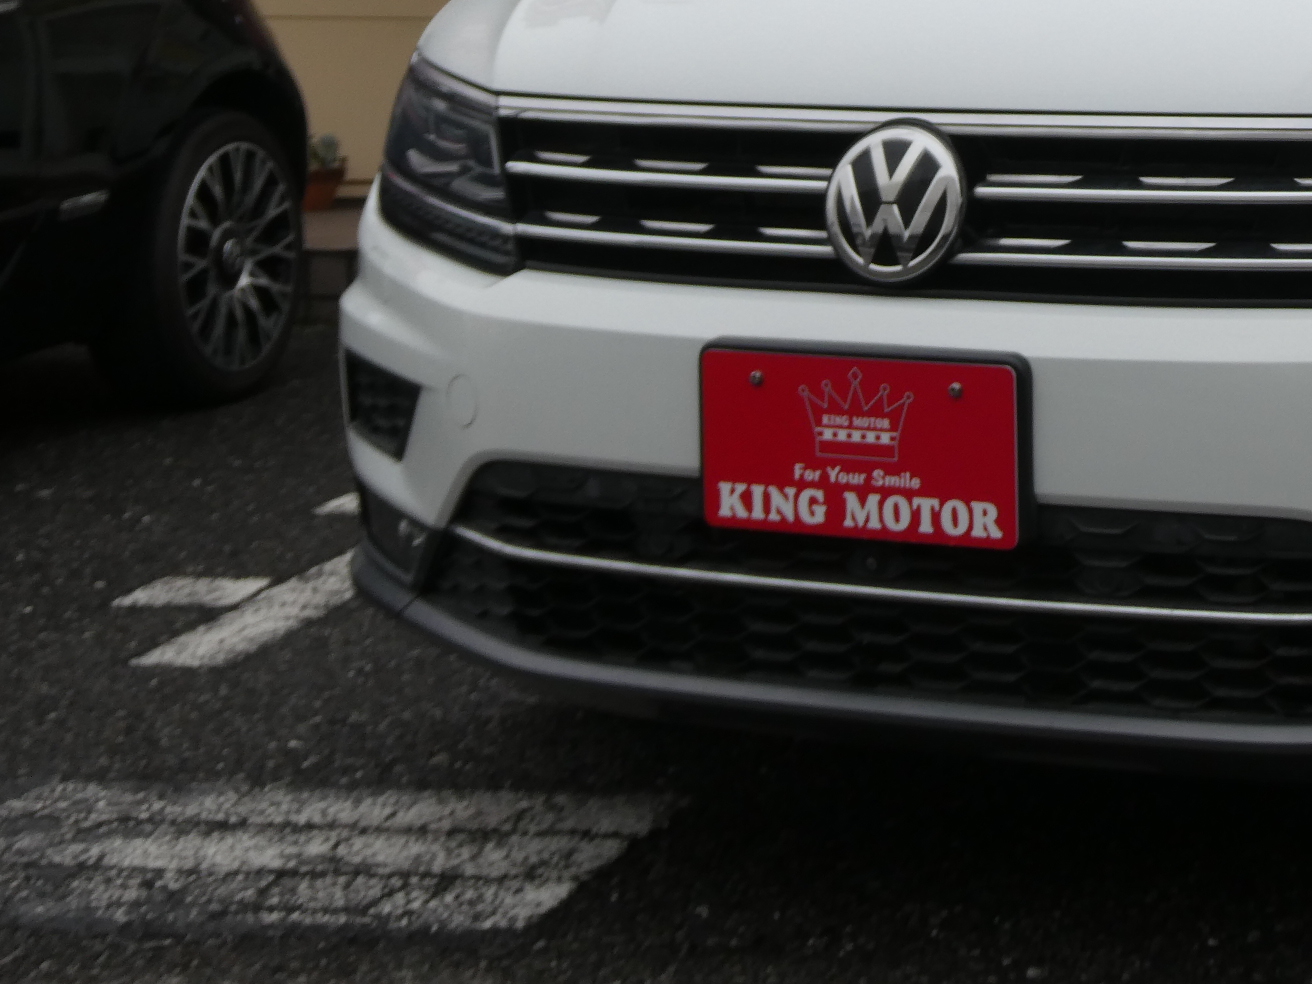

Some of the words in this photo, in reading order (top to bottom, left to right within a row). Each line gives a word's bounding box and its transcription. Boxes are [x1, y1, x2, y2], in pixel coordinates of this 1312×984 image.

[794, 463, 821, 482] For
[827, 466, 867, 486] Your
[871, 469, 921, 490] Smile
[717, 481, 827, 526] KING
[843, 491, 1003, 539] MOTOR
